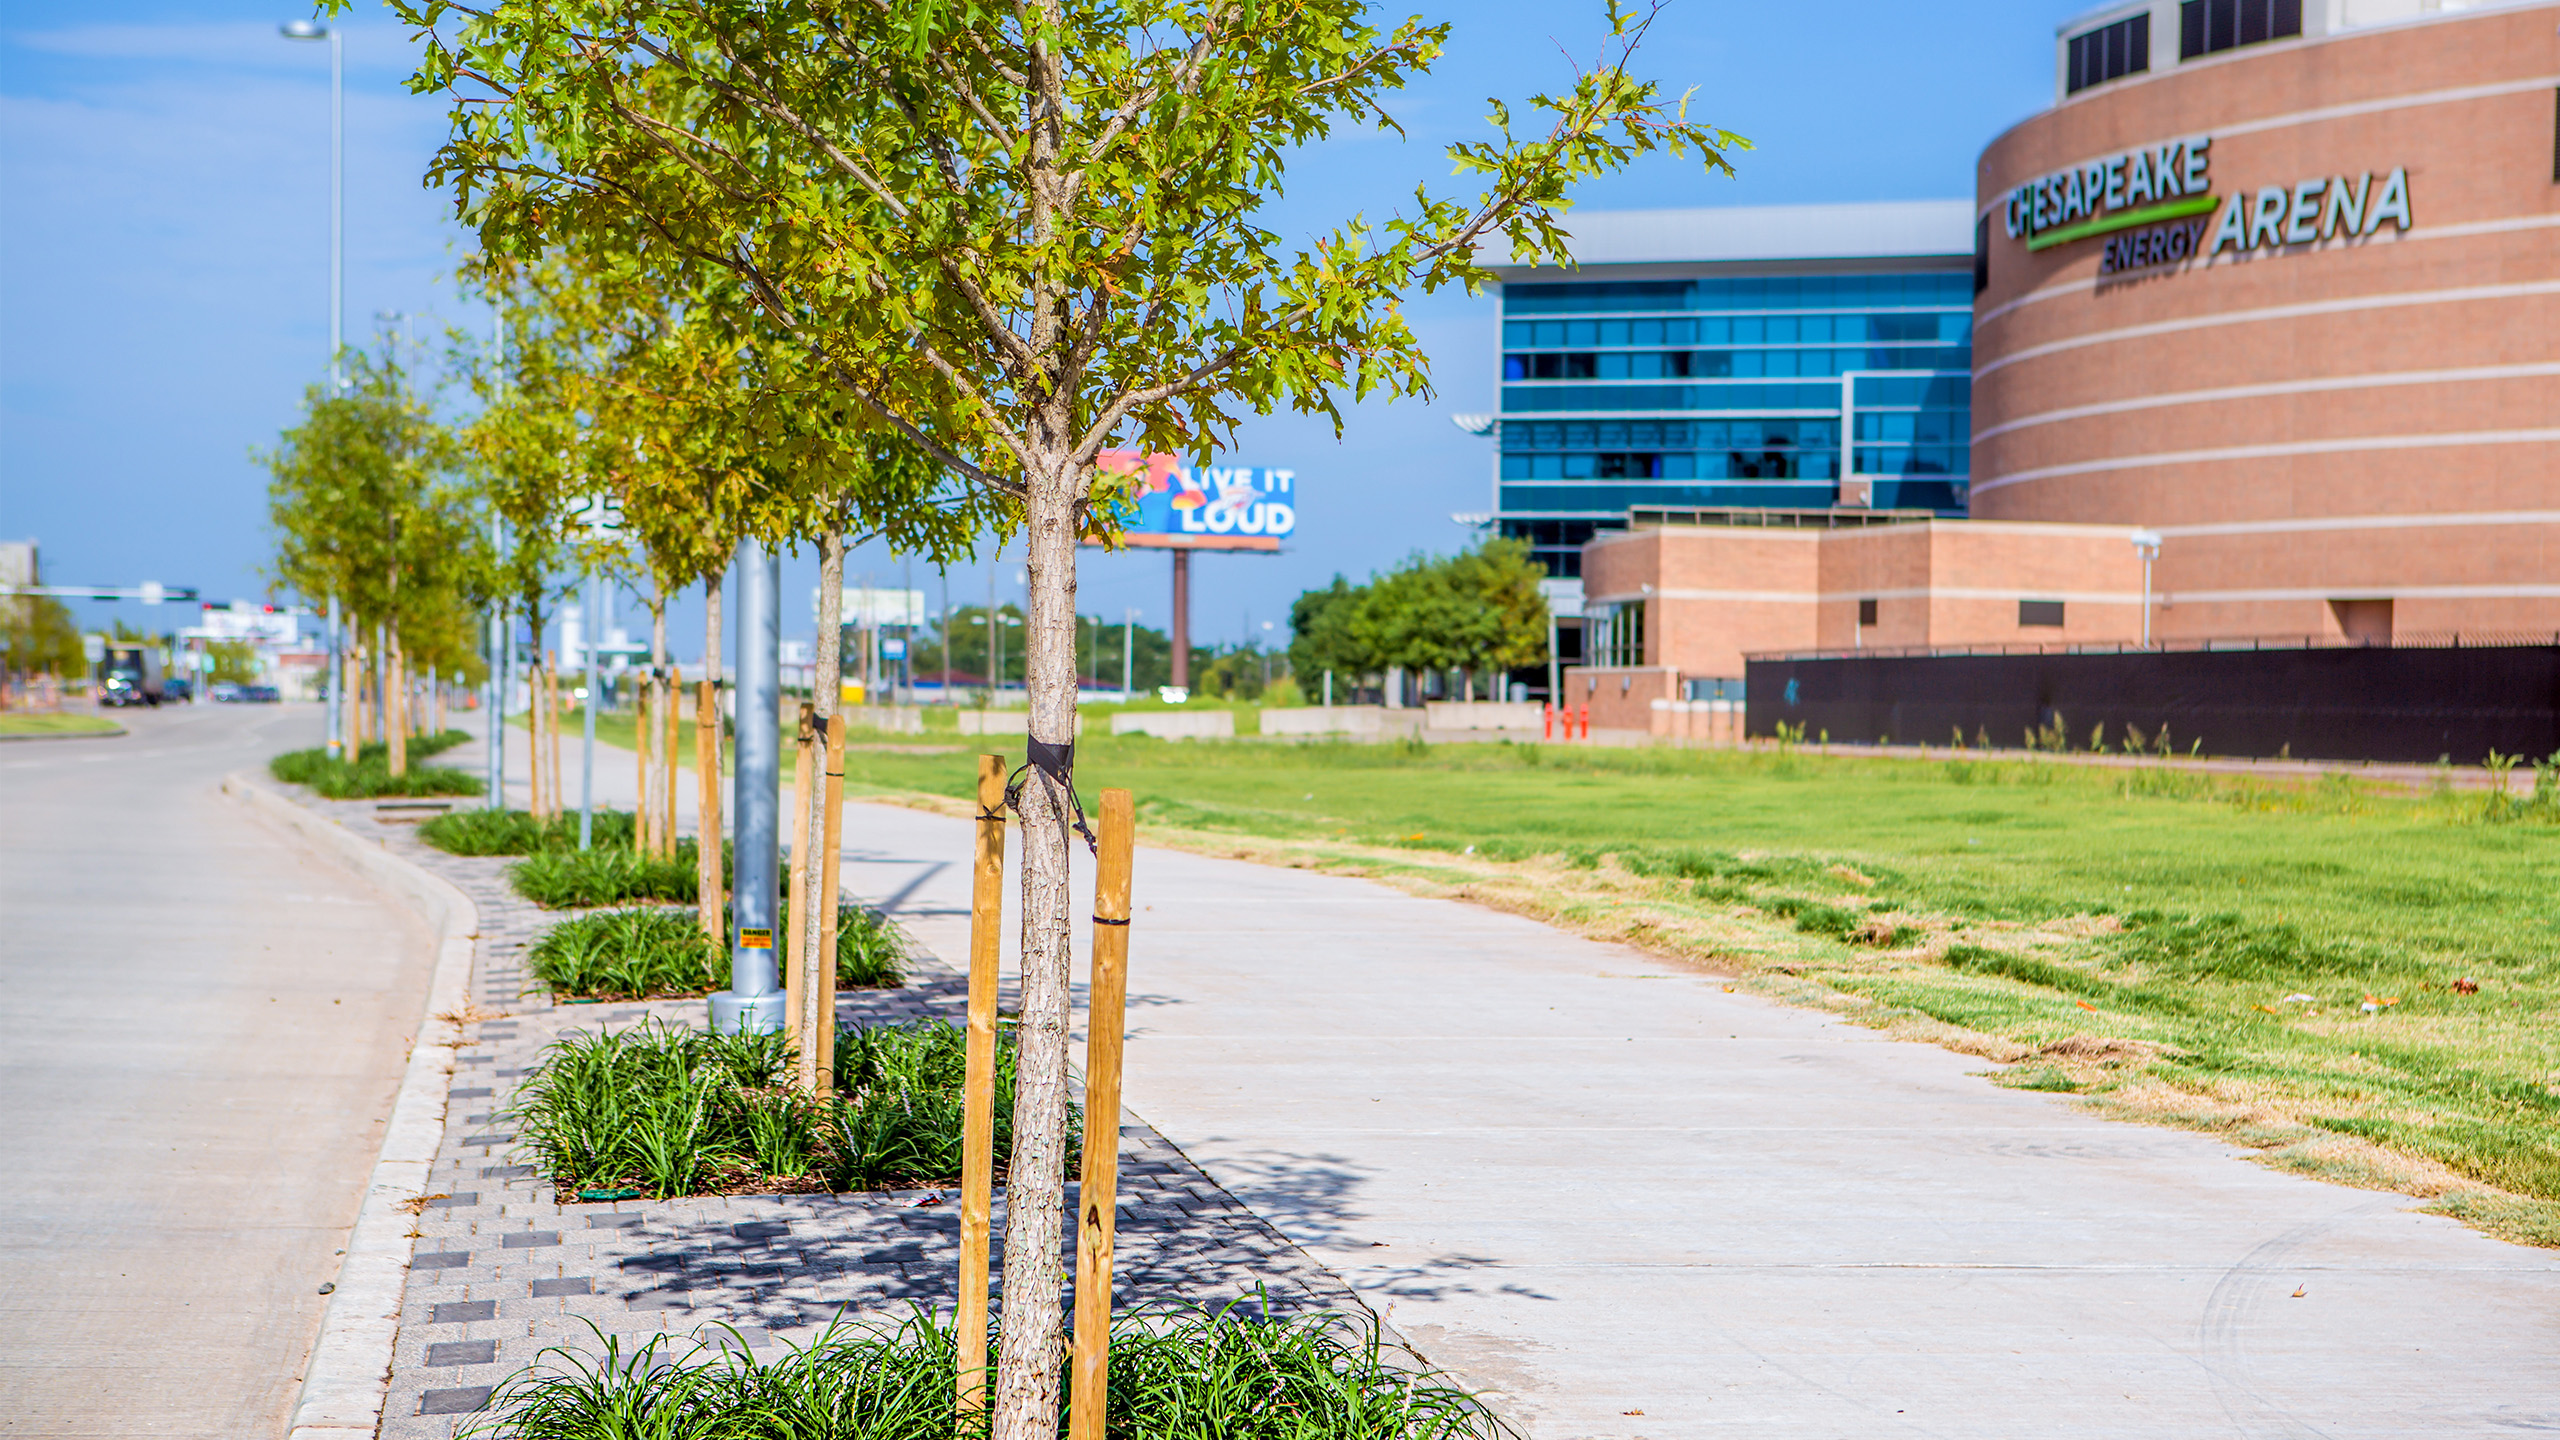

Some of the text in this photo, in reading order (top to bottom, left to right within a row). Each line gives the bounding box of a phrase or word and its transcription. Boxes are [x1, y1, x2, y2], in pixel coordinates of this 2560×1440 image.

[2005, 137, 2212, 240] CHESAPEAKE
[2210, 166, 2413, 255] ARENA
[2101, 219, 2208, 274] ENERGY
[1181, 468, 1295, 493] LIVE IT
[564, 494, 627, 529] 25
[1181, 502, 1296, 535] LOUD
